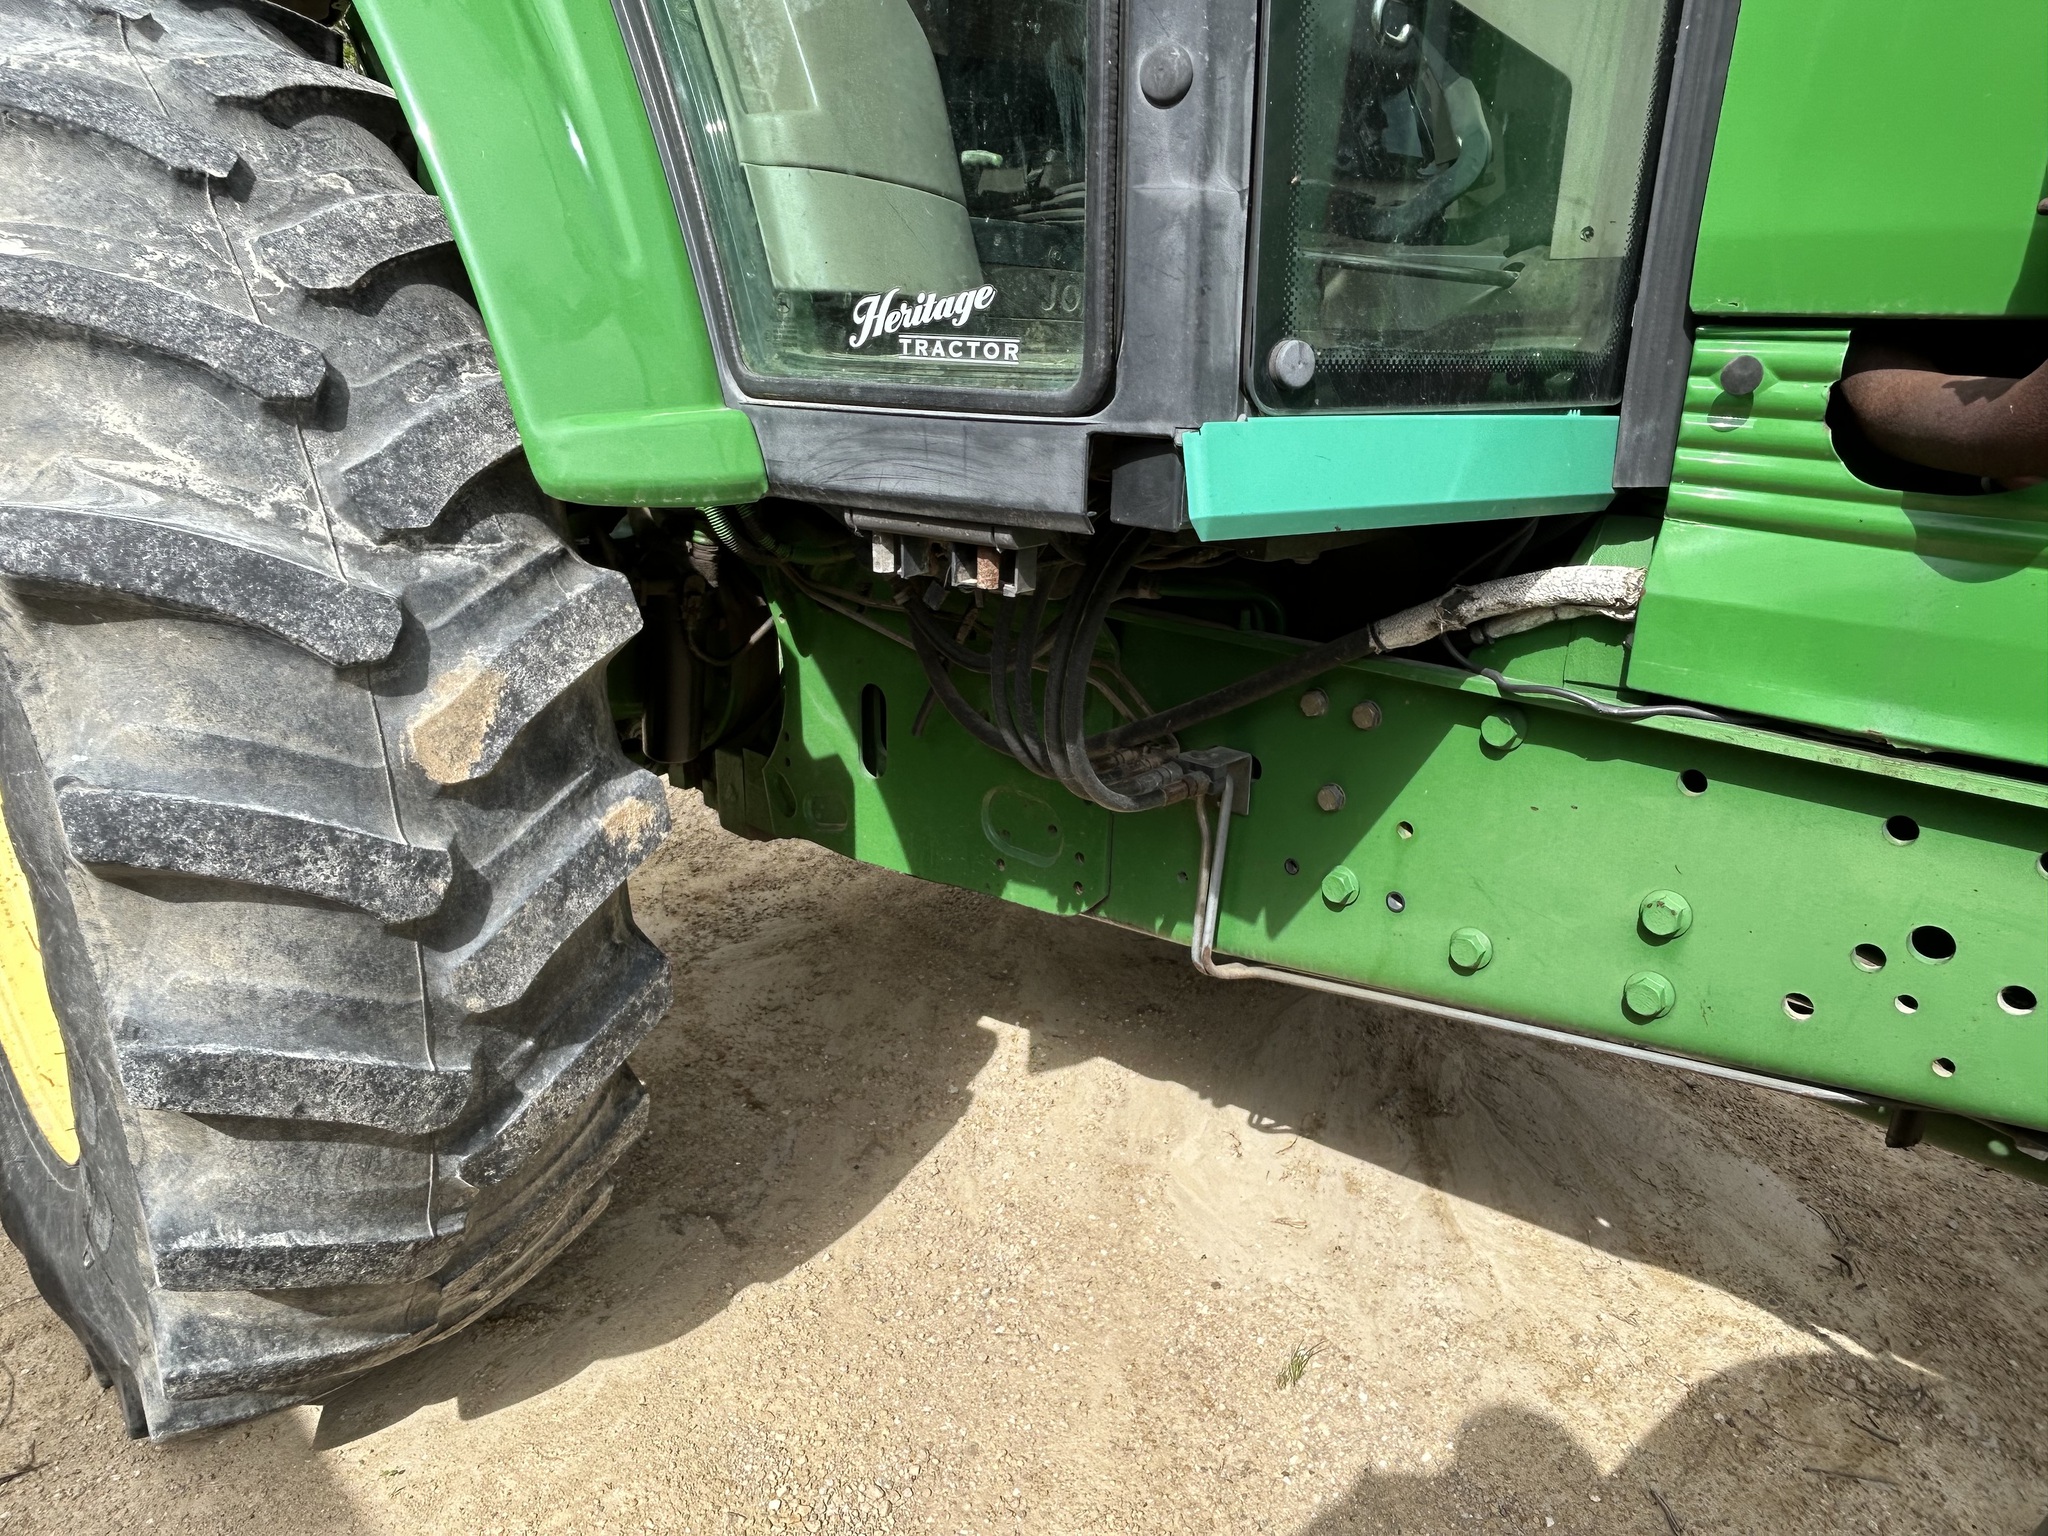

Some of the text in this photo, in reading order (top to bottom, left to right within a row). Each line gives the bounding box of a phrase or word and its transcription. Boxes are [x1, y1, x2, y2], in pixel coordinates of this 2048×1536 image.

[1041, 279, 1083, 314] JO
[849, 284, 997, 348] Heritage
[899, 339, 1019, 361] TRACTOR
